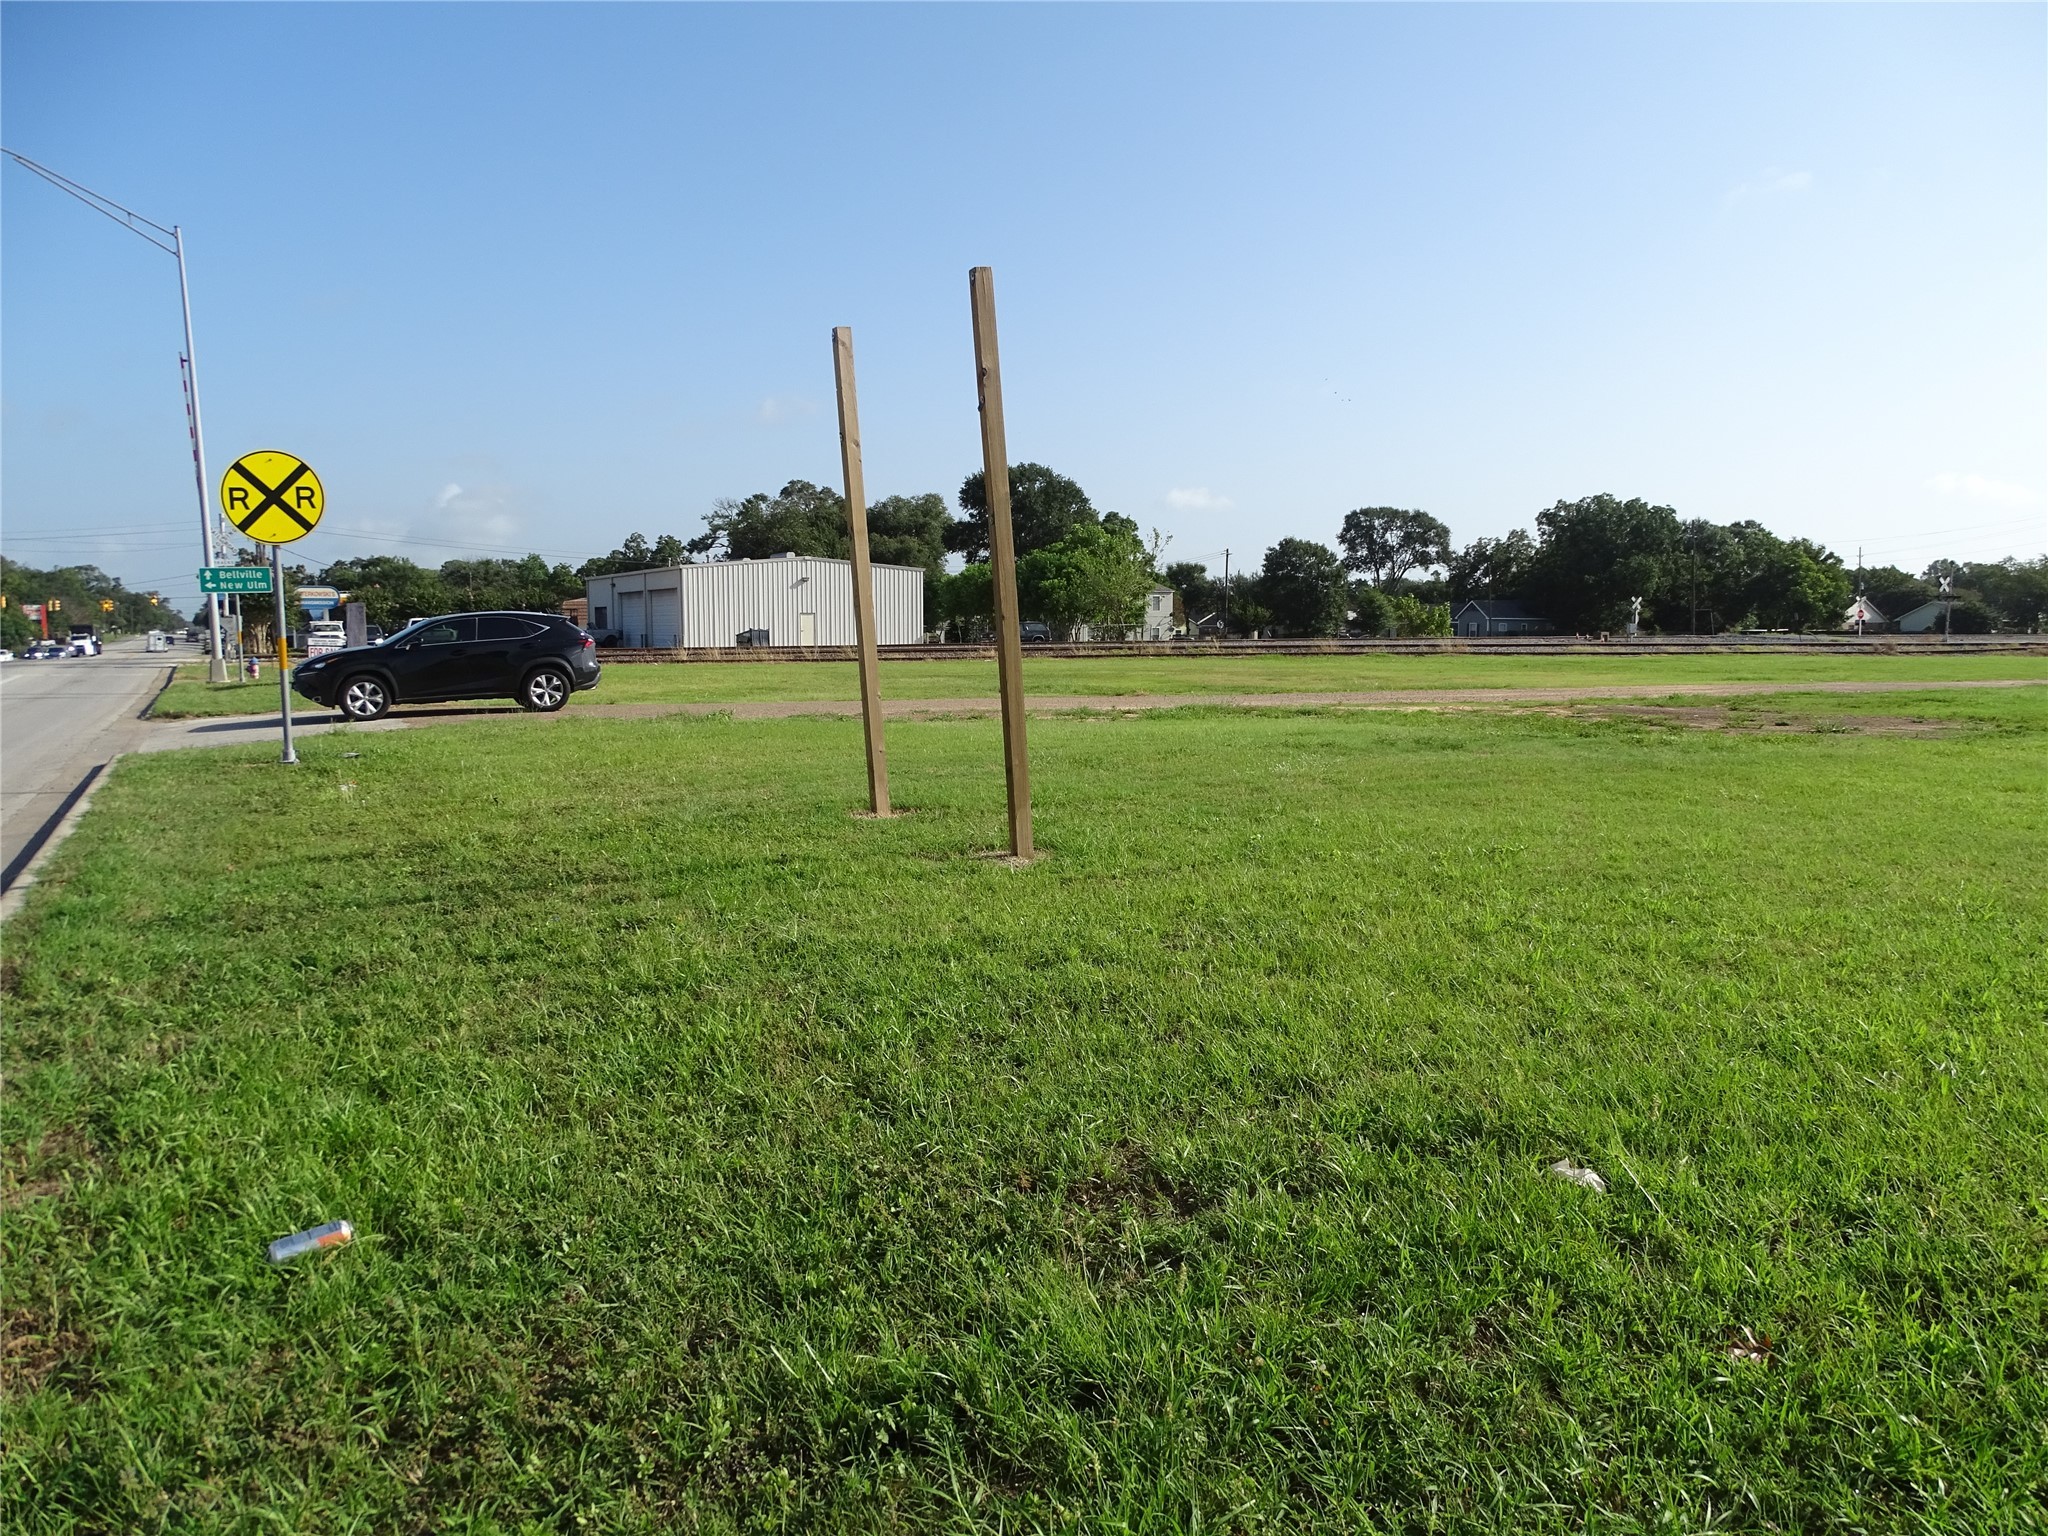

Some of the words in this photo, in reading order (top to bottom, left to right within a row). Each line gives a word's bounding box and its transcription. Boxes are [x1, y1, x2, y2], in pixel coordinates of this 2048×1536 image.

[228, 487, 250, 510] R
[295, 486, 316, 509] R
[219, 570, 263, 579] Bellville
[220, 581, 243, 589] New
[247, 581, 268, 589] Ulm
[310, 648, 323, 657] FOR
